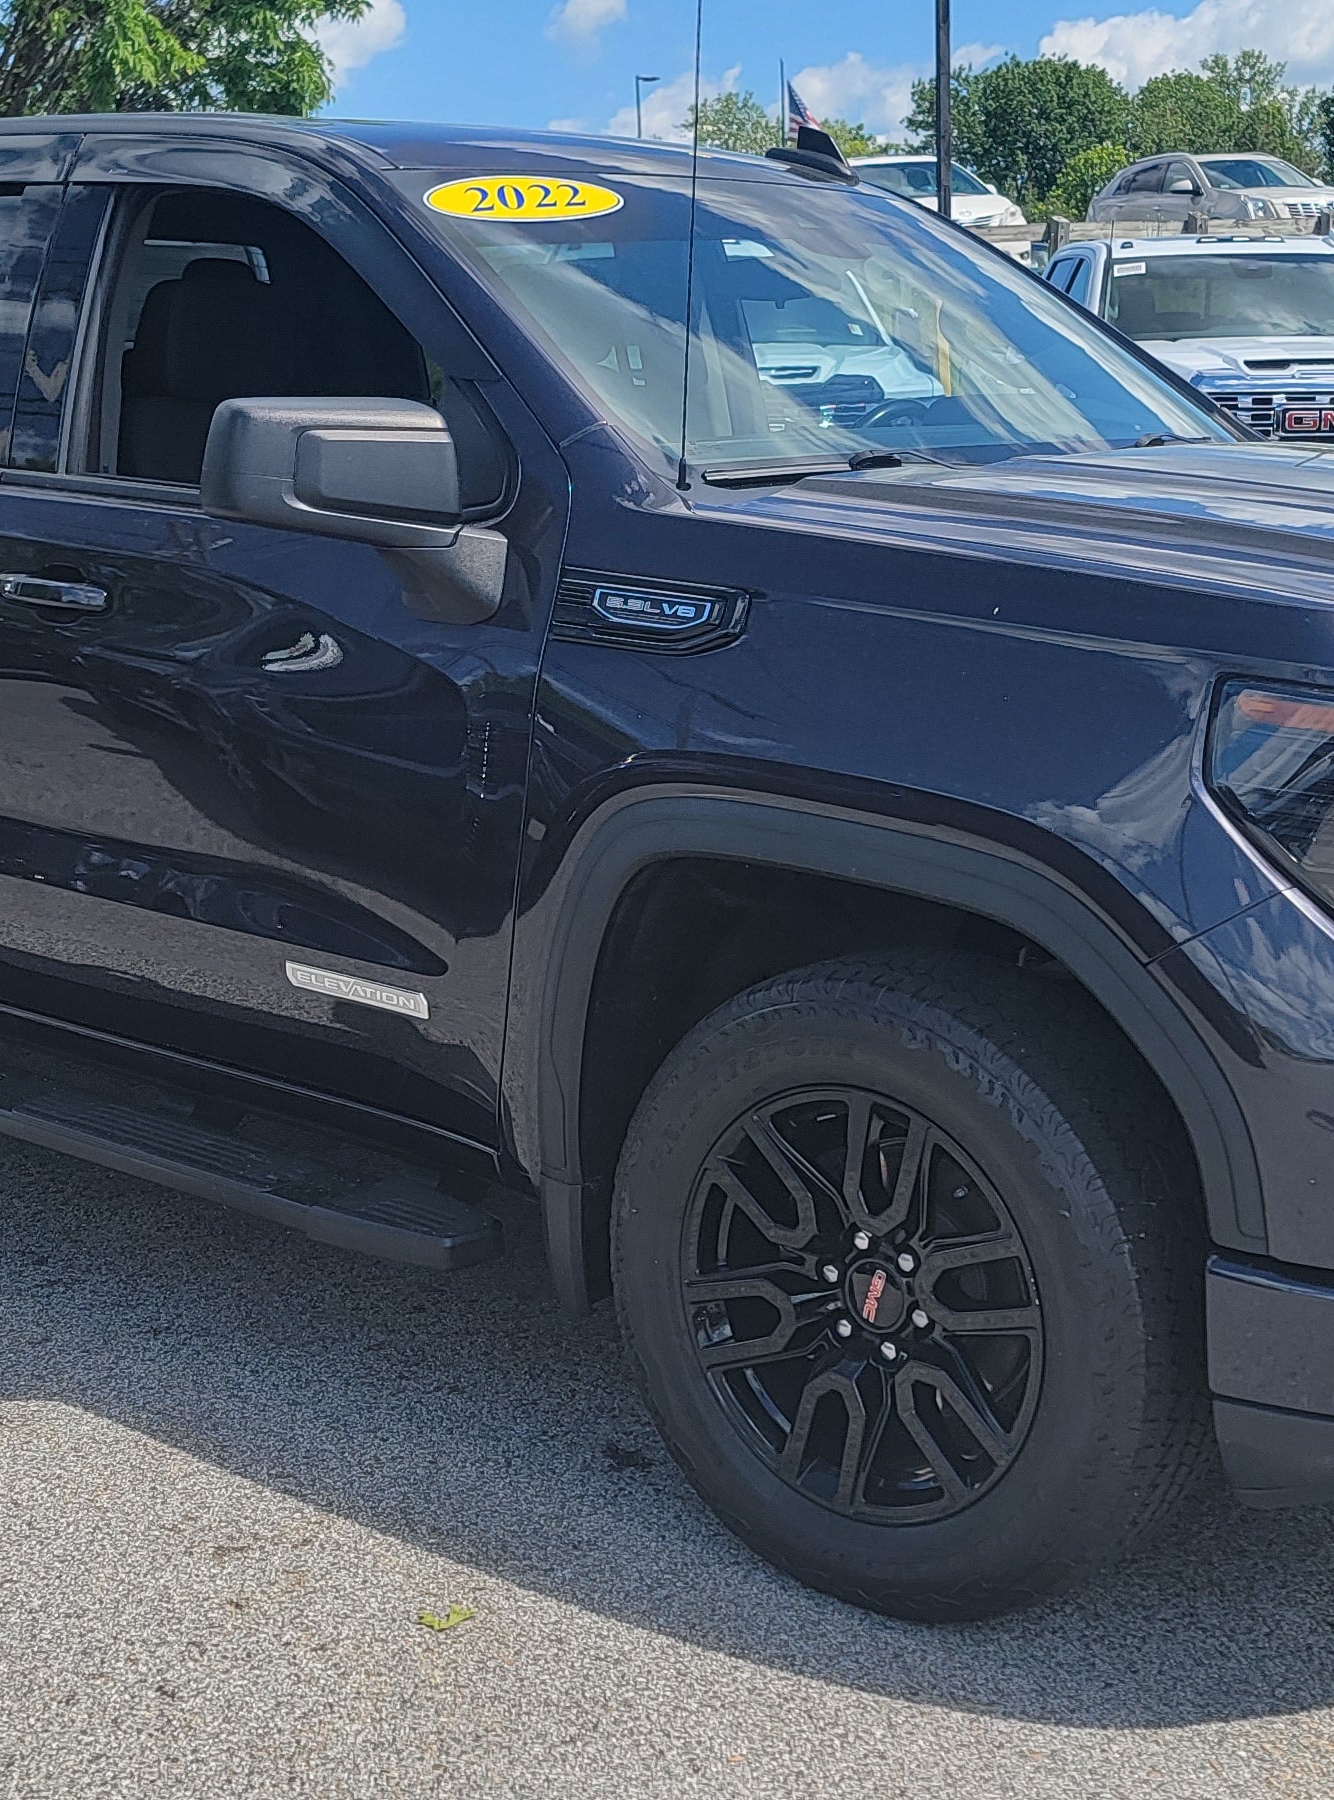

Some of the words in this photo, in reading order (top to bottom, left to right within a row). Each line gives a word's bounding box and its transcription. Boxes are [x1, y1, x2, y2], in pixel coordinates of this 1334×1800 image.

[464, 184, 586, 213] 2022
[296, 970, 416, 1010] ELEVATION
[862, 1269, 887, 1324] GMC
